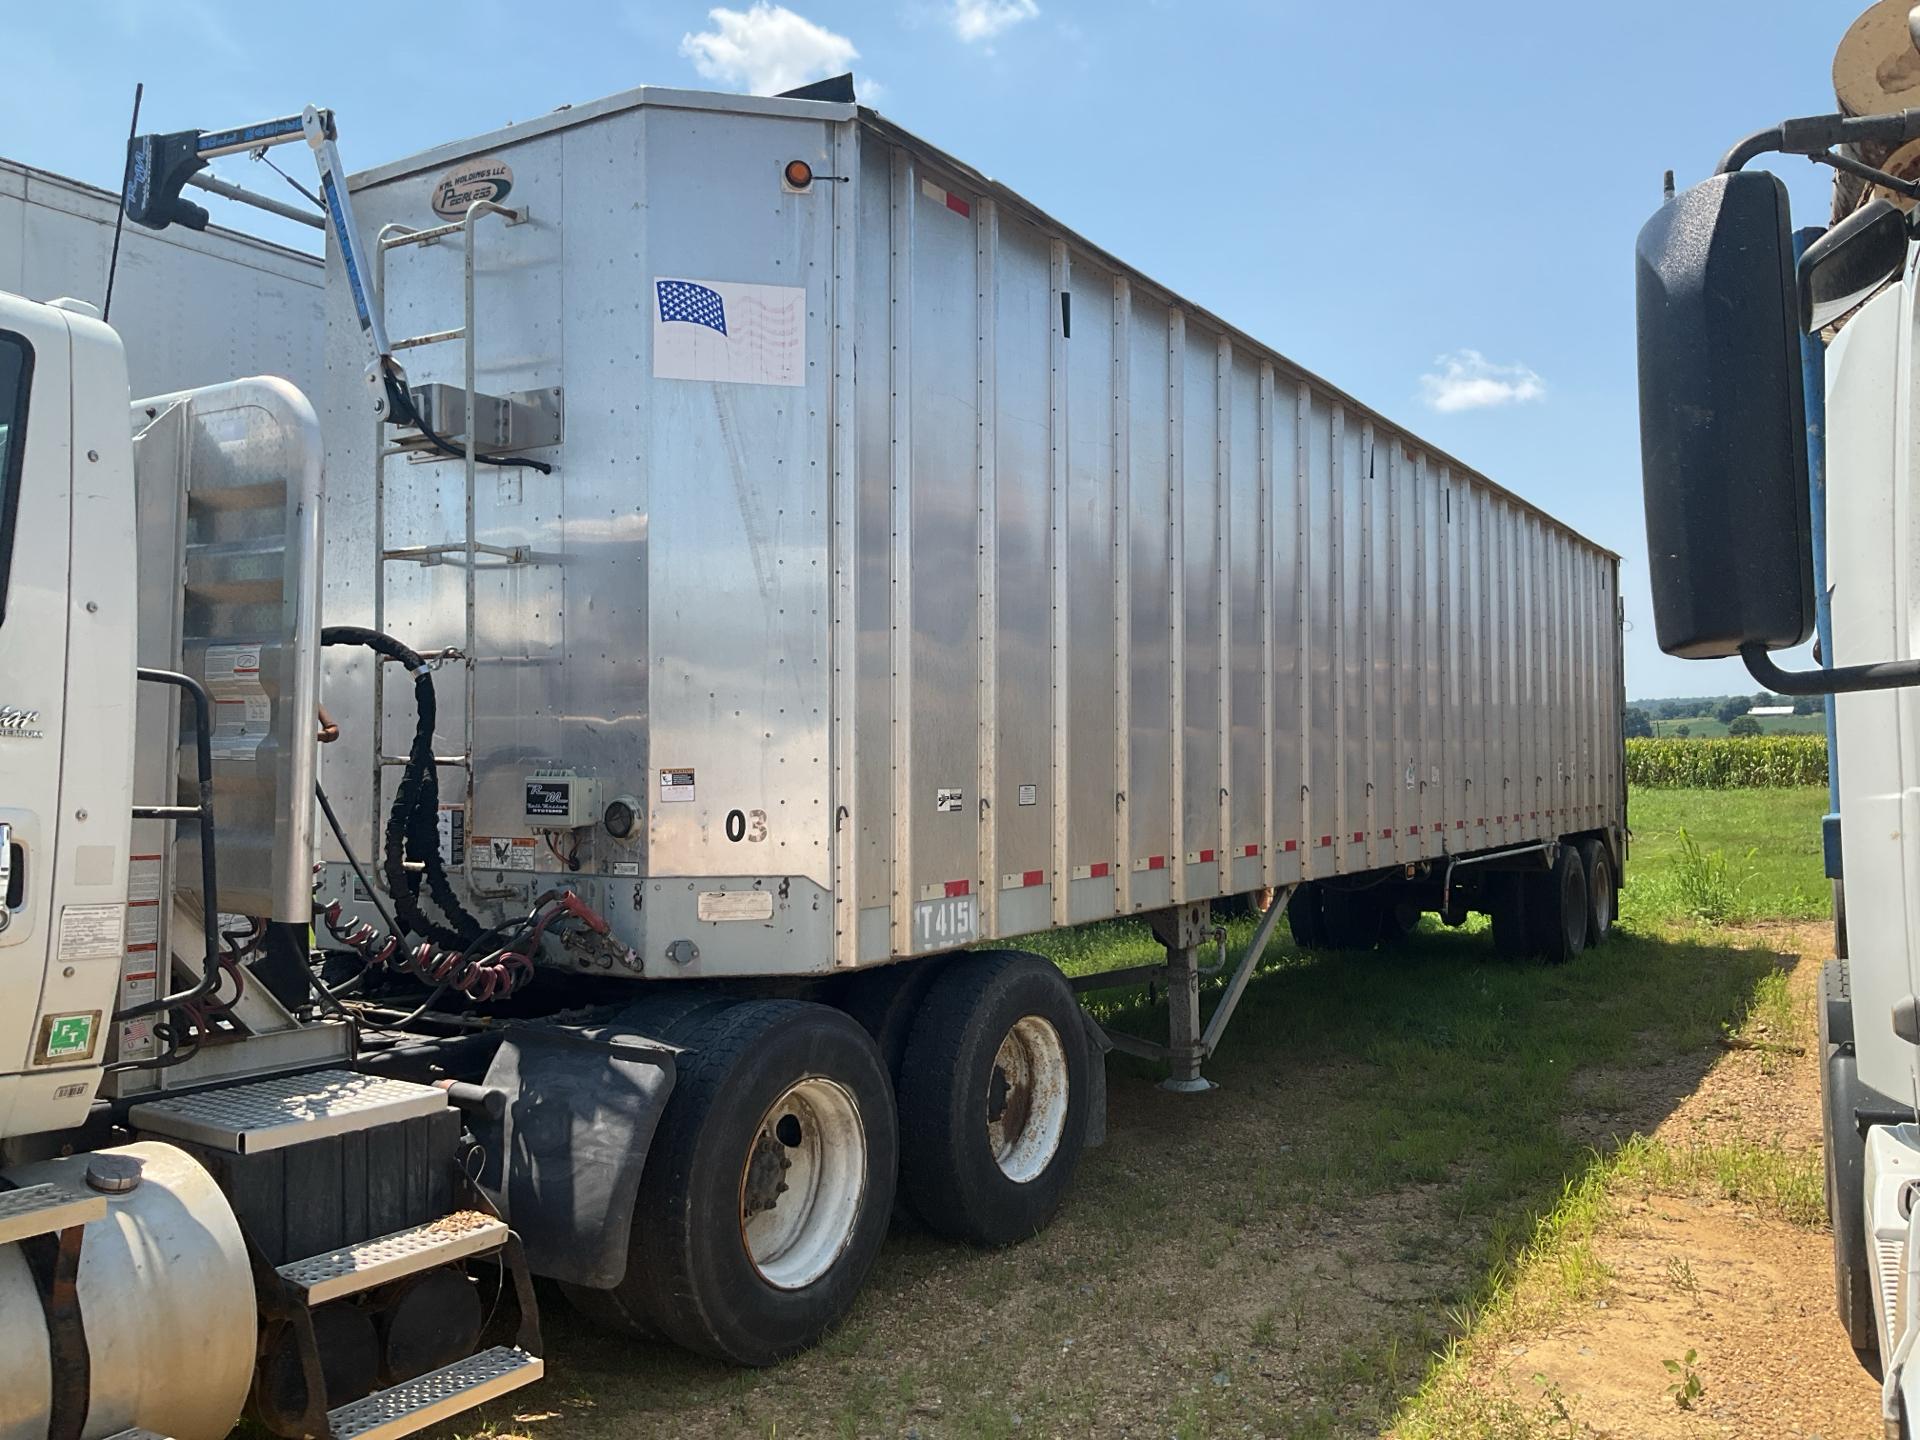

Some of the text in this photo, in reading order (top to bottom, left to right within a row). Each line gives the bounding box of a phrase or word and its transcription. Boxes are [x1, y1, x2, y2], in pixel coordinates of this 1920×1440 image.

[492, 166, 506, 176] LLC
[725, 808, 768, 843] 03
[920, 901, 969, 939] T415
